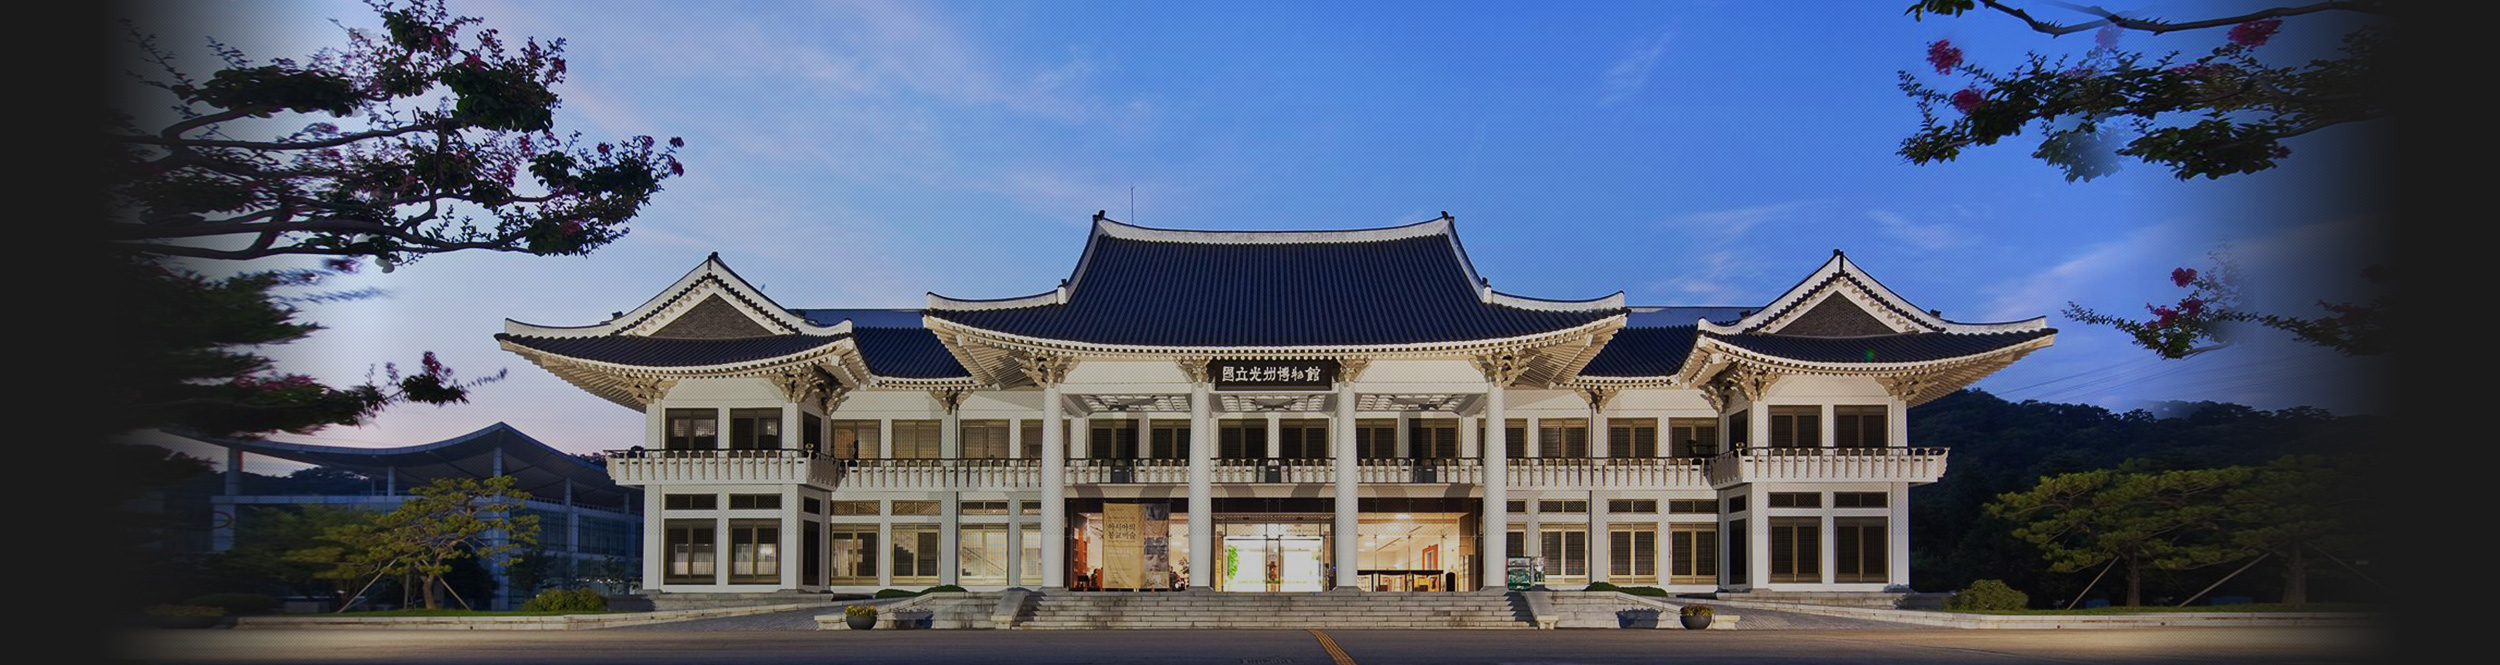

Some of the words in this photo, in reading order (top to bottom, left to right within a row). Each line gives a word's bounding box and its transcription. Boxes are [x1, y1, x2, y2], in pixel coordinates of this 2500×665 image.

[1222, 366, 1320, 382] 國立光州博物館
[1108, 523, 1136, 531] 아시아의
[1108, 531, 1136, 540] 불교미술
